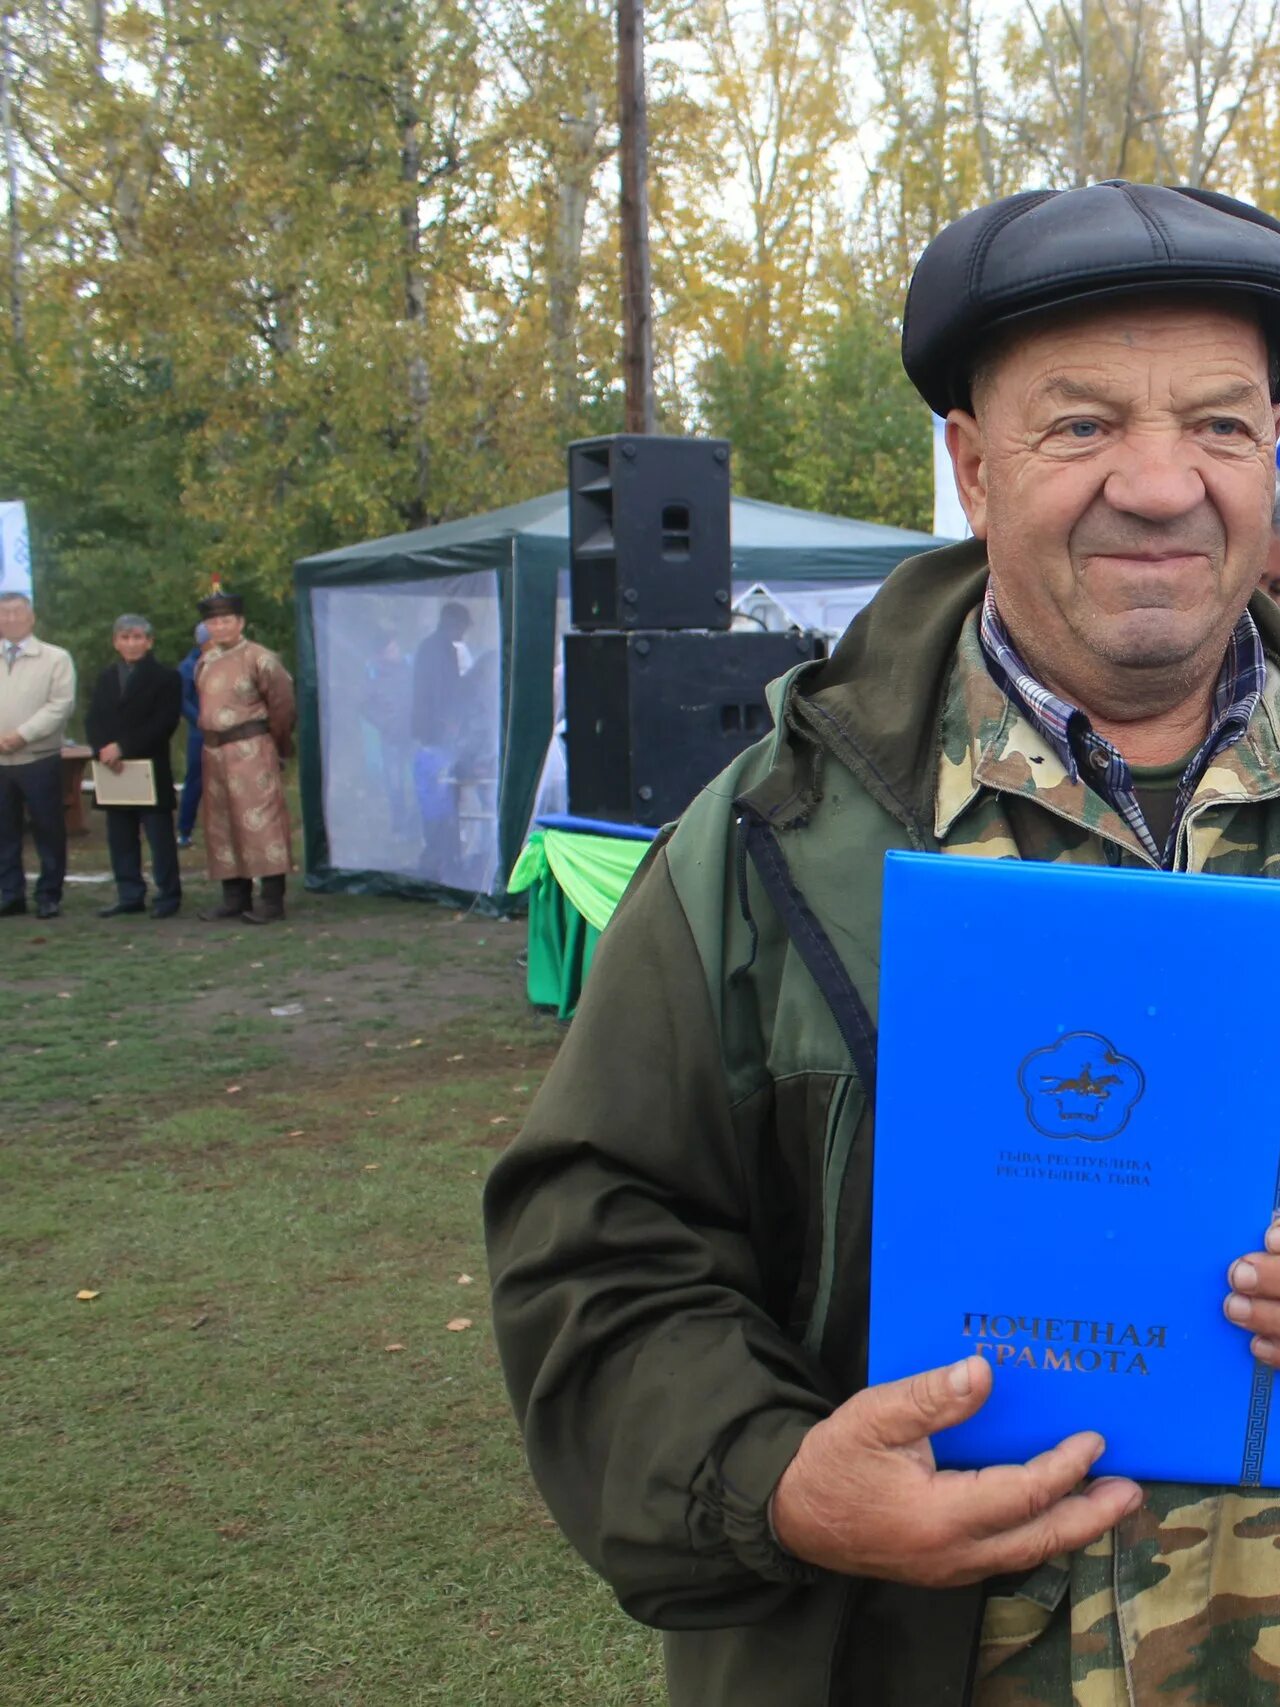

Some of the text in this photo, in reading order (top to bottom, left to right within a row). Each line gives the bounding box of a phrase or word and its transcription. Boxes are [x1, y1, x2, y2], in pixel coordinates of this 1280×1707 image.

[999, 1151, 1152, 1171] ТЫВА РЕСПУБЛИКА
[996, 1166, 1150, 1186] РЕСПУБЛИКА ТЫВА
[961, 1312, 1168, 1348] ПОЧЕТНАЯ
[974, 1342, 1150, 1375] ГРАМОТА
